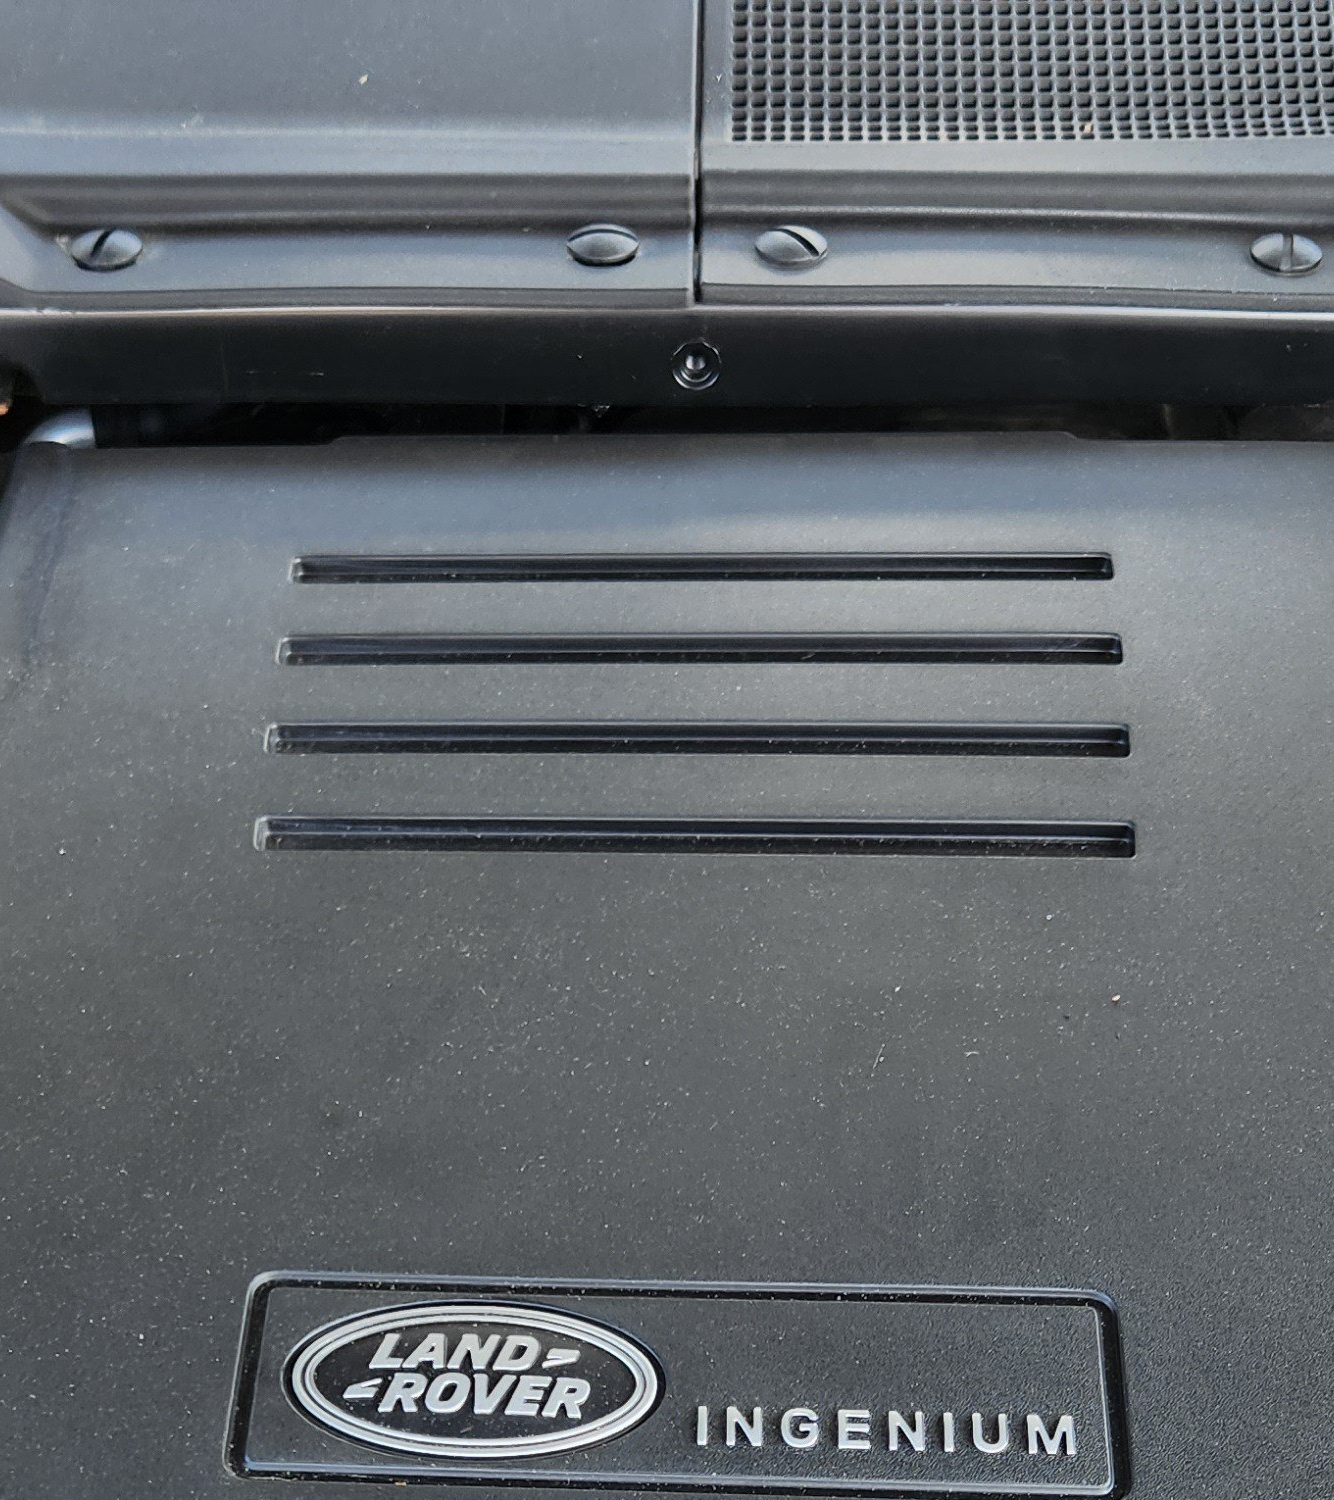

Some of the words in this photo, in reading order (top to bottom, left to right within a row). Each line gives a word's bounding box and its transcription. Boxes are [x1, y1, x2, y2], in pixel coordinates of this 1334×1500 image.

[369, 1332, 541, 1372] LAND
[378, 1372, 591, 1420] ROVER
[696, 1405, 1076, 1456] INGENIUM
